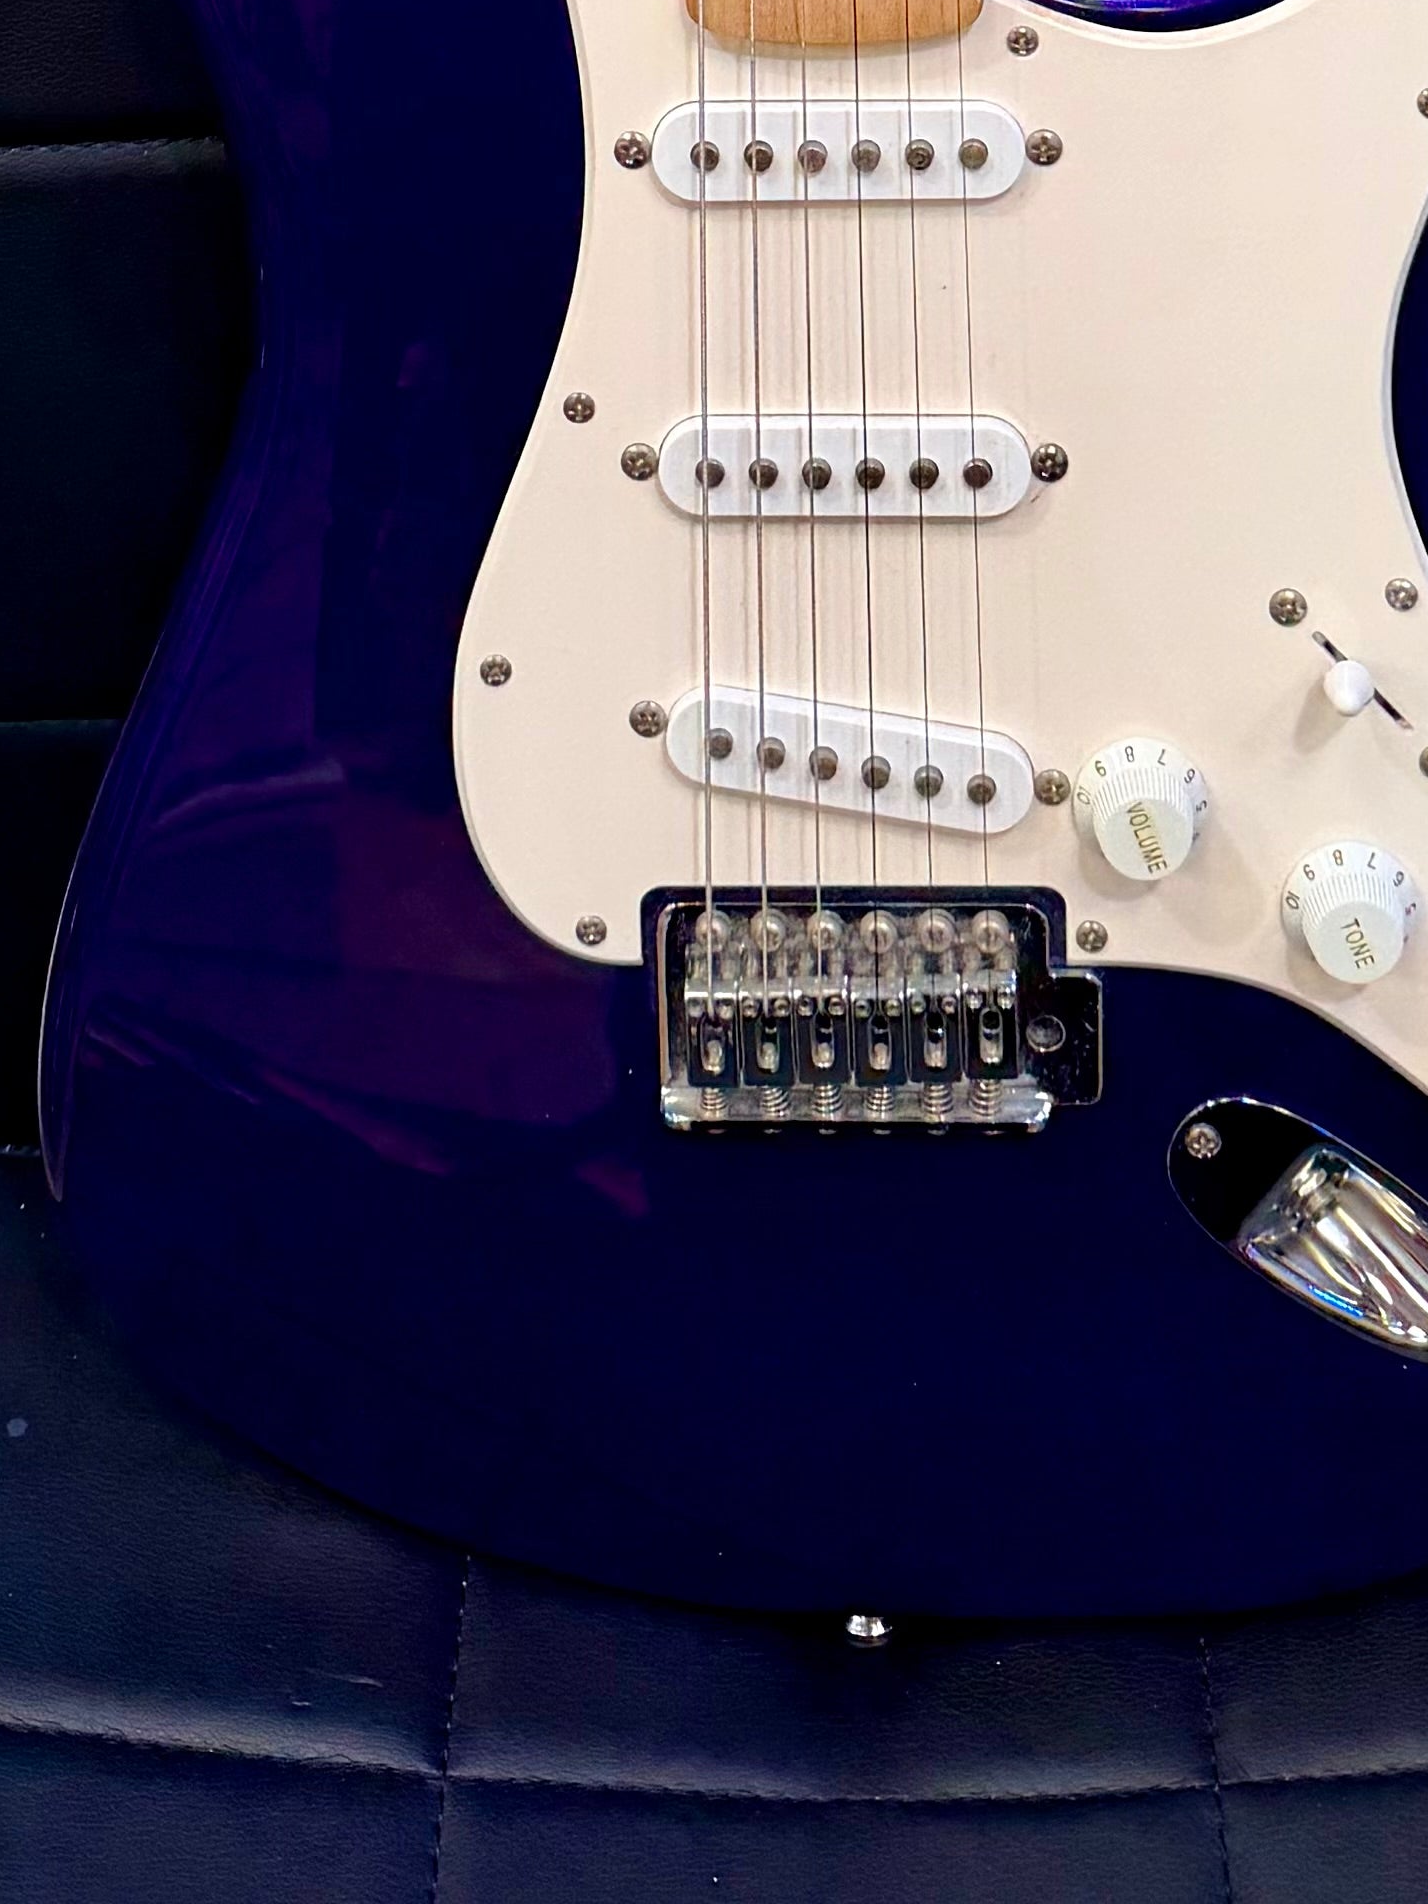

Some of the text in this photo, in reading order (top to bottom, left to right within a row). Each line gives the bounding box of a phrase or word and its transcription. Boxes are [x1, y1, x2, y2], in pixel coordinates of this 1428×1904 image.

[1094, 760, 1107, 777] 9
[1124, 746, 1135, 763] 8
[1157, 748, 1166, 766] 7
[1183, 768, 1196, 784] 6
[1126, 801, 1168, 874] VOLUME
[1285, 890, 1300, 910] 10
[1303, 864, 1315, 881] 9
[1332, 849, 1344, 866] 8
[1367, 852, 1376, 870] 7
[1393, 871, 1405, 887] 6
[1340, 917, 1375, 969] TONE
